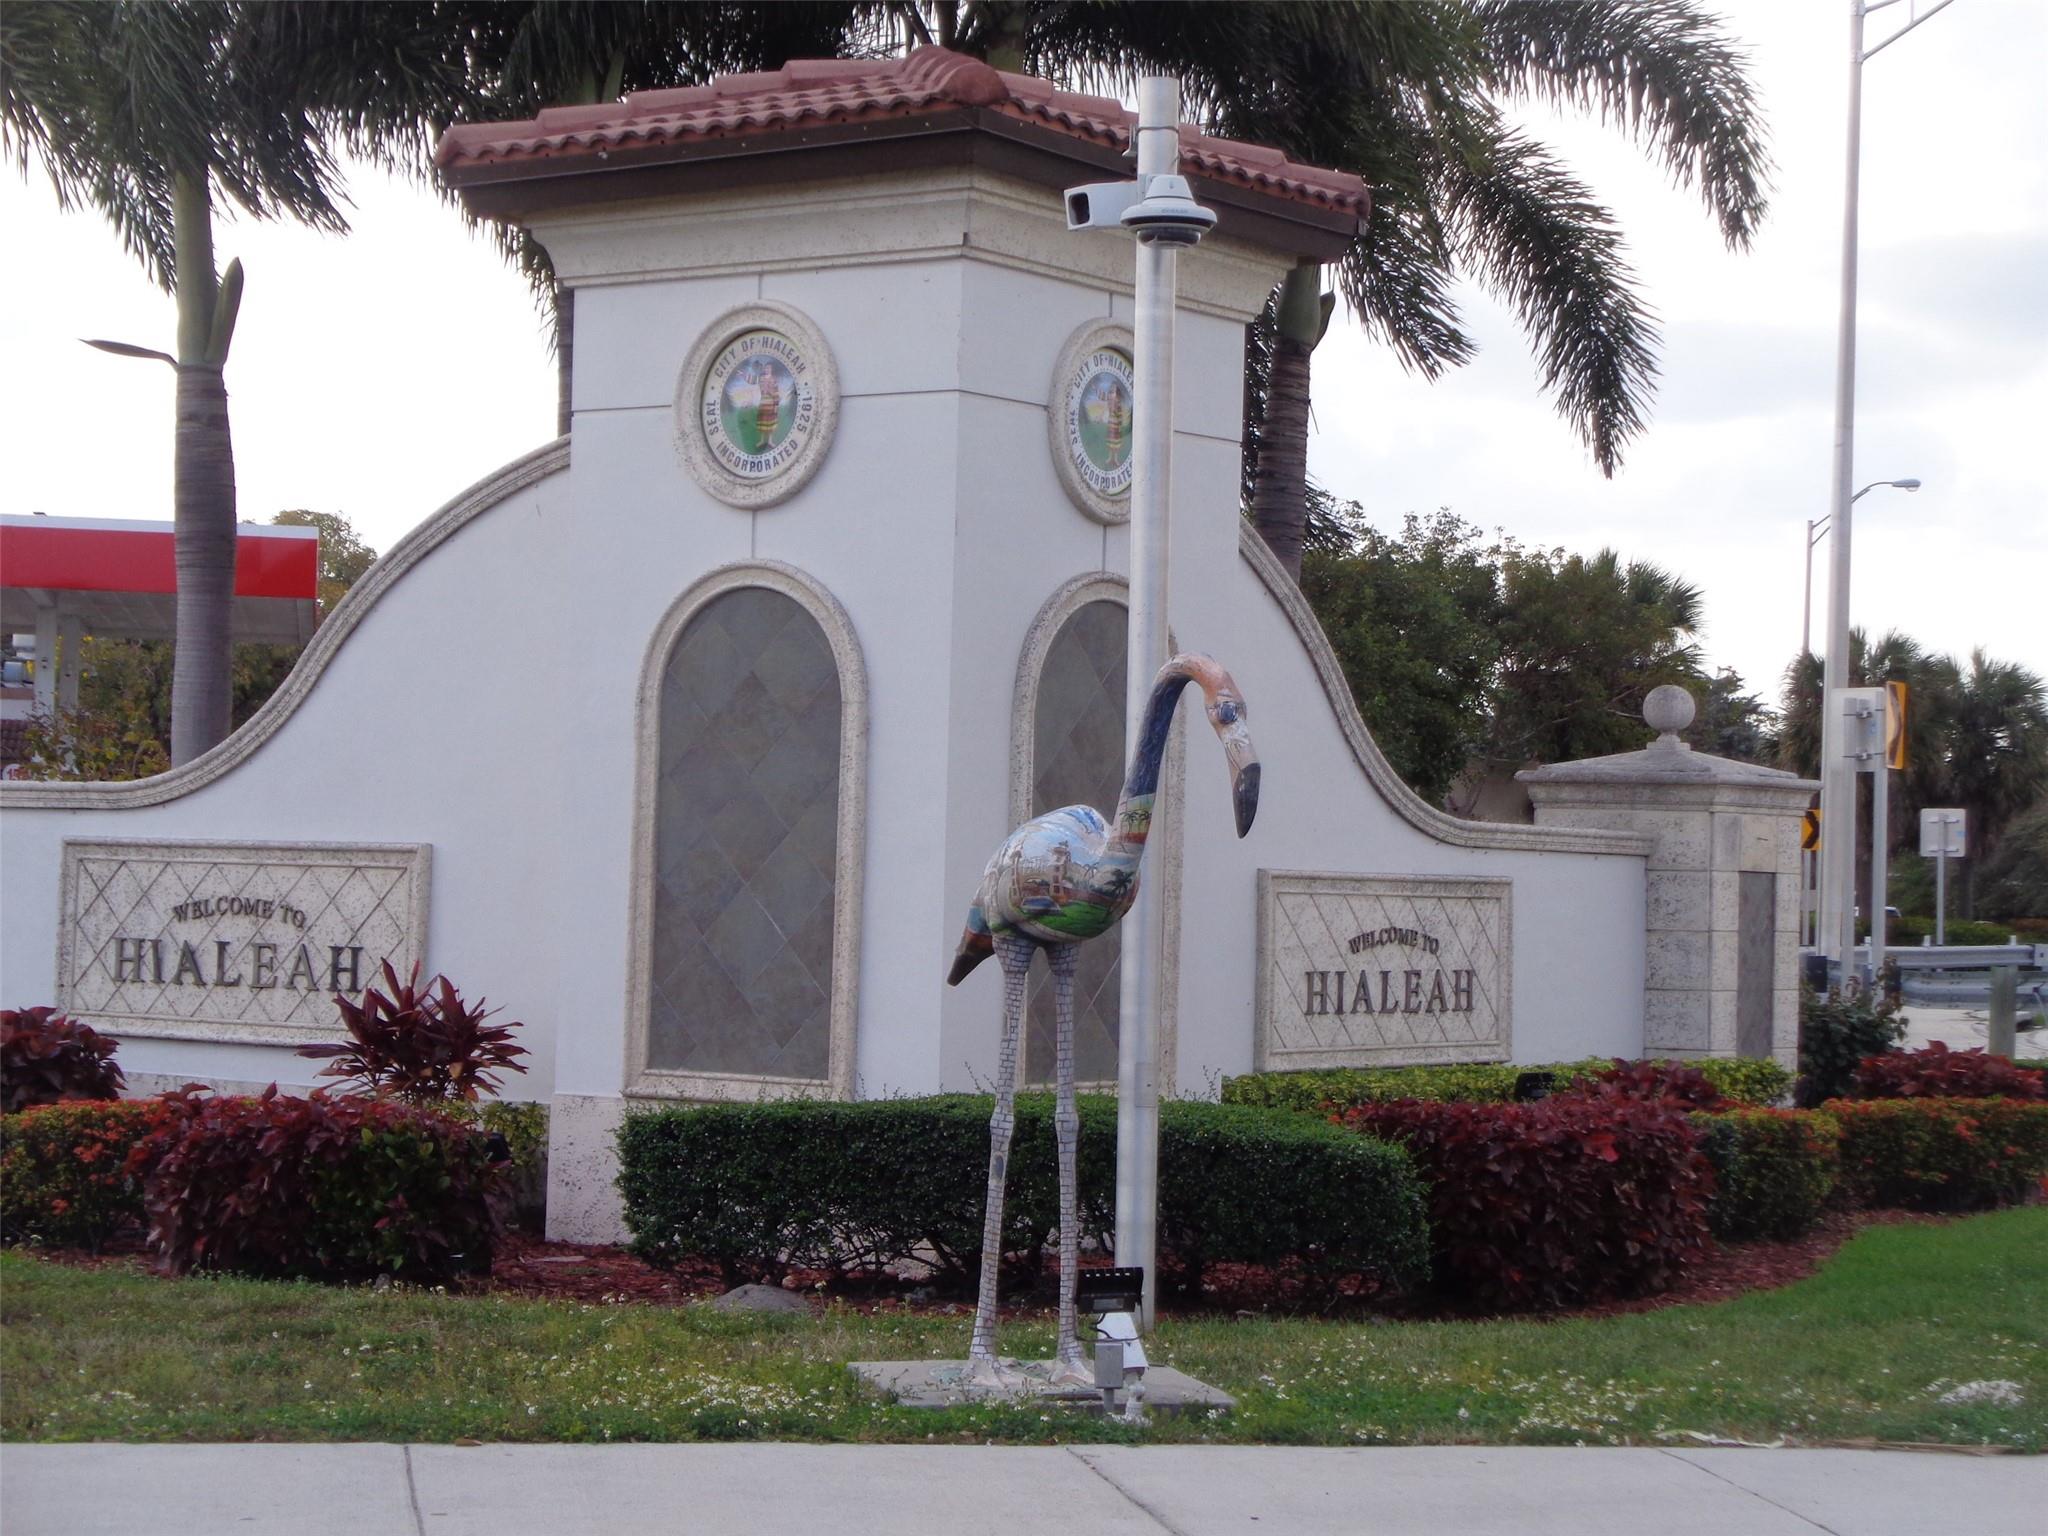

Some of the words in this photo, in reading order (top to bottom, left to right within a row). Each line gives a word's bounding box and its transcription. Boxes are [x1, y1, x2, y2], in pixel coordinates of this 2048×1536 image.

[714, 349, 737, 379] CITY
[741, 337, 755, 353] OF
[762, 336, 807, 375] HIALEAH
[1074, 361, 1091, 389] CITY
[1093, 353, 1105, 367] OF
[705, 399, 720, 436] SEAL
[716, 439, 798, 473] INCORPORATED
[796, 395, 812, 434] 1925
[172, 895, 273, 925] WELCOME
[280, 905, 306, 930] TO
[1347, 926, 1419, 955] WELCOME
[1421, 932, 1441, 955] TO
[111, 935, 364, 994] HIALEAH
[1304, 968, 1477, 1017] HIALEAH
